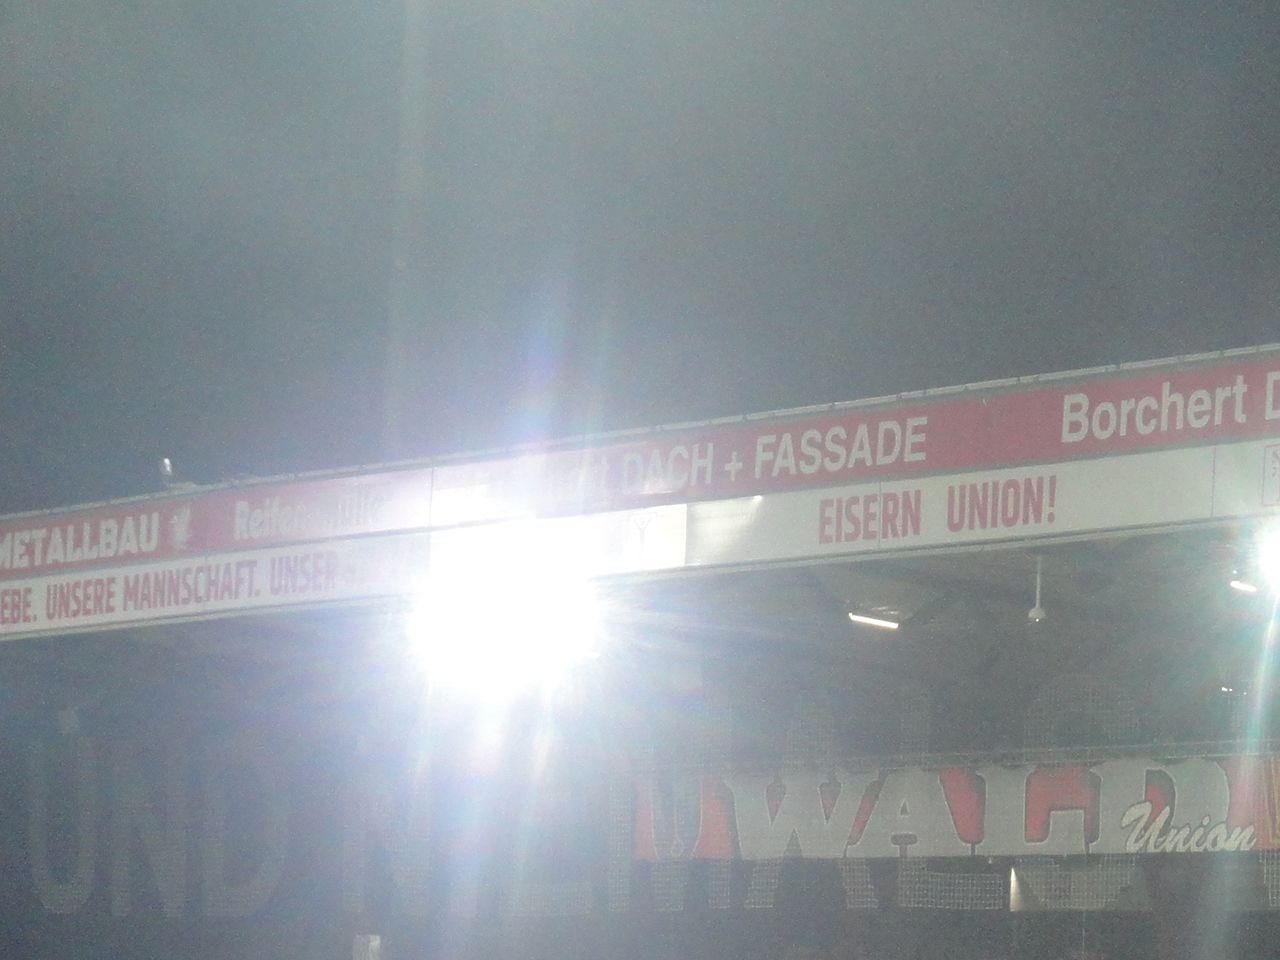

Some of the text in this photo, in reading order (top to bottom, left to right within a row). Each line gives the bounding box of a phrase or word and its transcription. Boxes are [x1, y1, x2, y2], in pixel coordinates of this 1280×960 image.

[1062, 373, 1249, 444] Borchert
[753, 415, 928, 480] FASSADE
[818, 474, 1058, 546] EISERN UNION!
[45, 573, 117, 621] UNSERE
[122, 555, 261, 612] MANNSCHAFT.
[1120, 800, 1258, 853] Union
